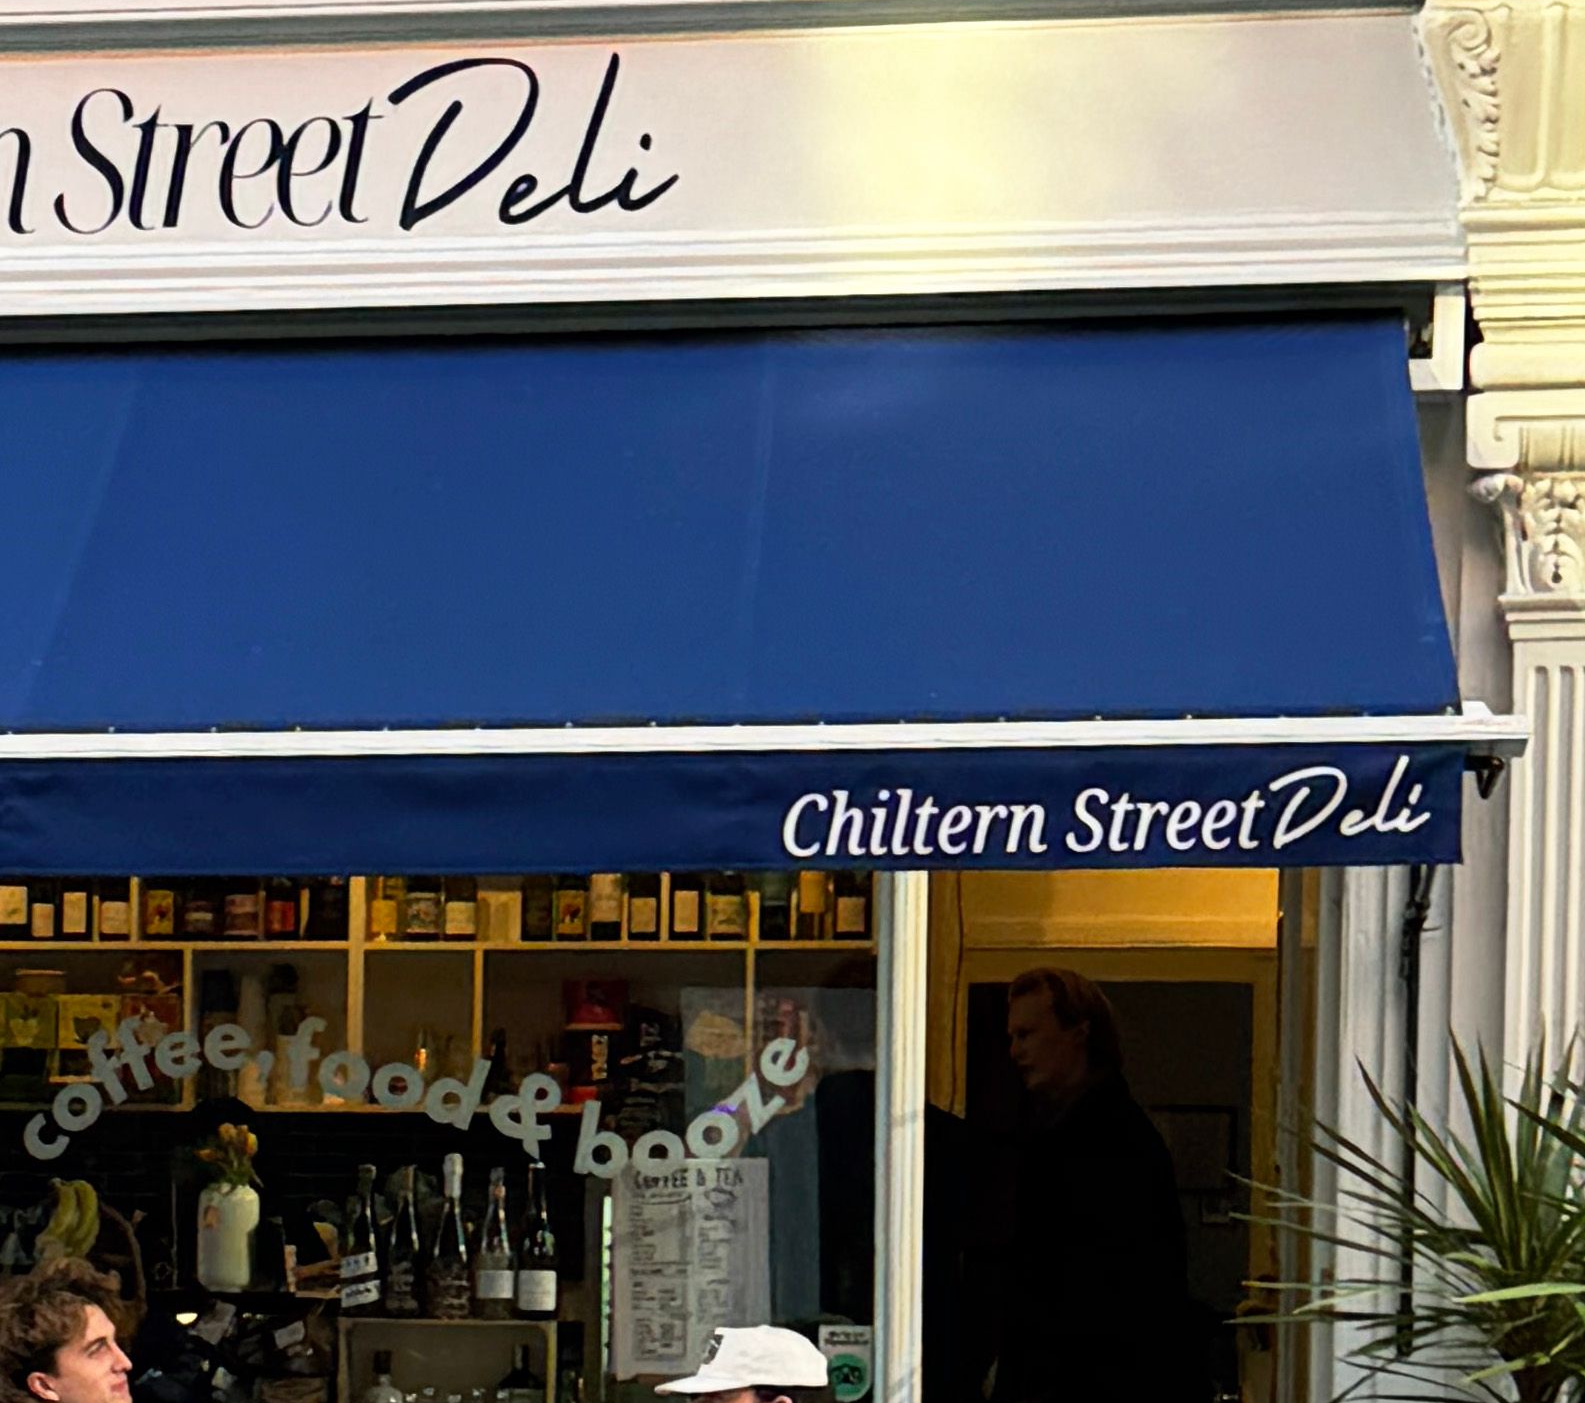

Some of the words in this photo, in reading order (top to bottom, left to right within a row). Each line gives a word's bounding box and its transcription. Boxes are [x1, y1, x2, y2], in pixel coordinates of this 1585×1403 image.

[54, 87, 384, 235] Street
[387, 52, 680, 232] Deli
[782, 788, 1048, 857] Chiltern
[1065, 787, 1266, 854] Street
[1269, 755, 1431, 849] Deli
[23, 1014, 274, 1161] coffee,
[284, 1016, 492, 1131] food
[489, 1073, 562, 1159] &
[573, 1037, 810, 1179] booze
